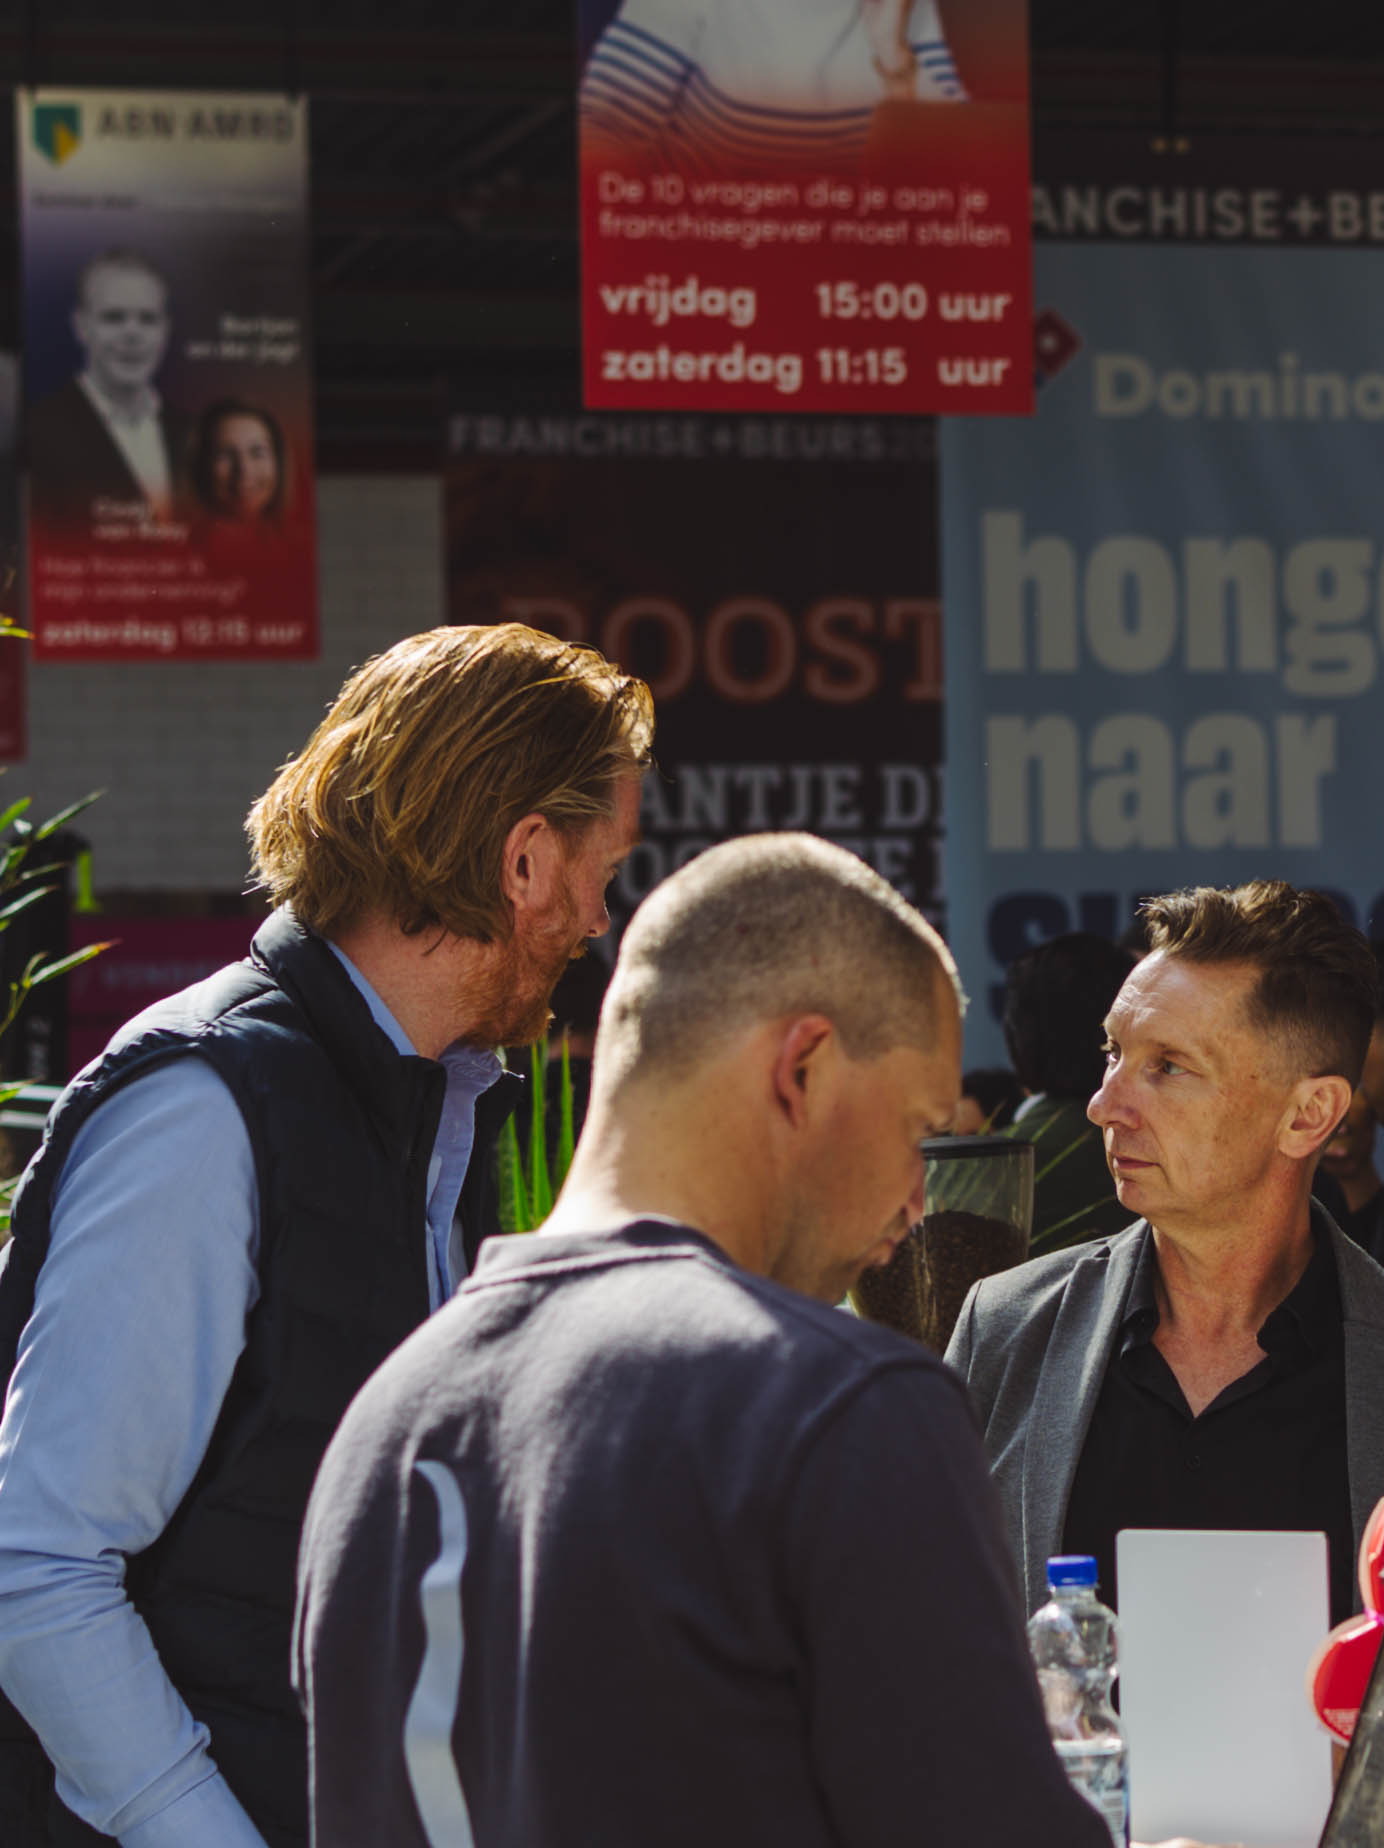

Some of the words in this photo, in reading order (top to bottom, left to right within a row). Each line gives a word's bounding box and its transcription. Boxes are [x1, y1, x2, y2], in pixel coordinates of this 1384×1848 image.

[599, 171, 645, 203] De
[650, 173, 685, 205] 10
[690, 178, 799, 214] vragen
[804, 177, 854, 210] die
[859, 178, 888, 217] je
[893, 183, 954, 212] aan
[958, 182, 989, 222] je
[598, 209, 823, 250] franchisegever
[829, 217, 910, 247] moet
[915, 215, 1012, 248] stellen
[599, 272, 758, 330] vrijdag
[814, 281, 928, 322] 15:00
[936, 290, 1015, 323] uur
[601, 342, 803, 394] zaterdag
[815, 346, 909, 386] 11:15
[936, 356, 1013, 388] uur
[984, 711, 1338, 851] naar
